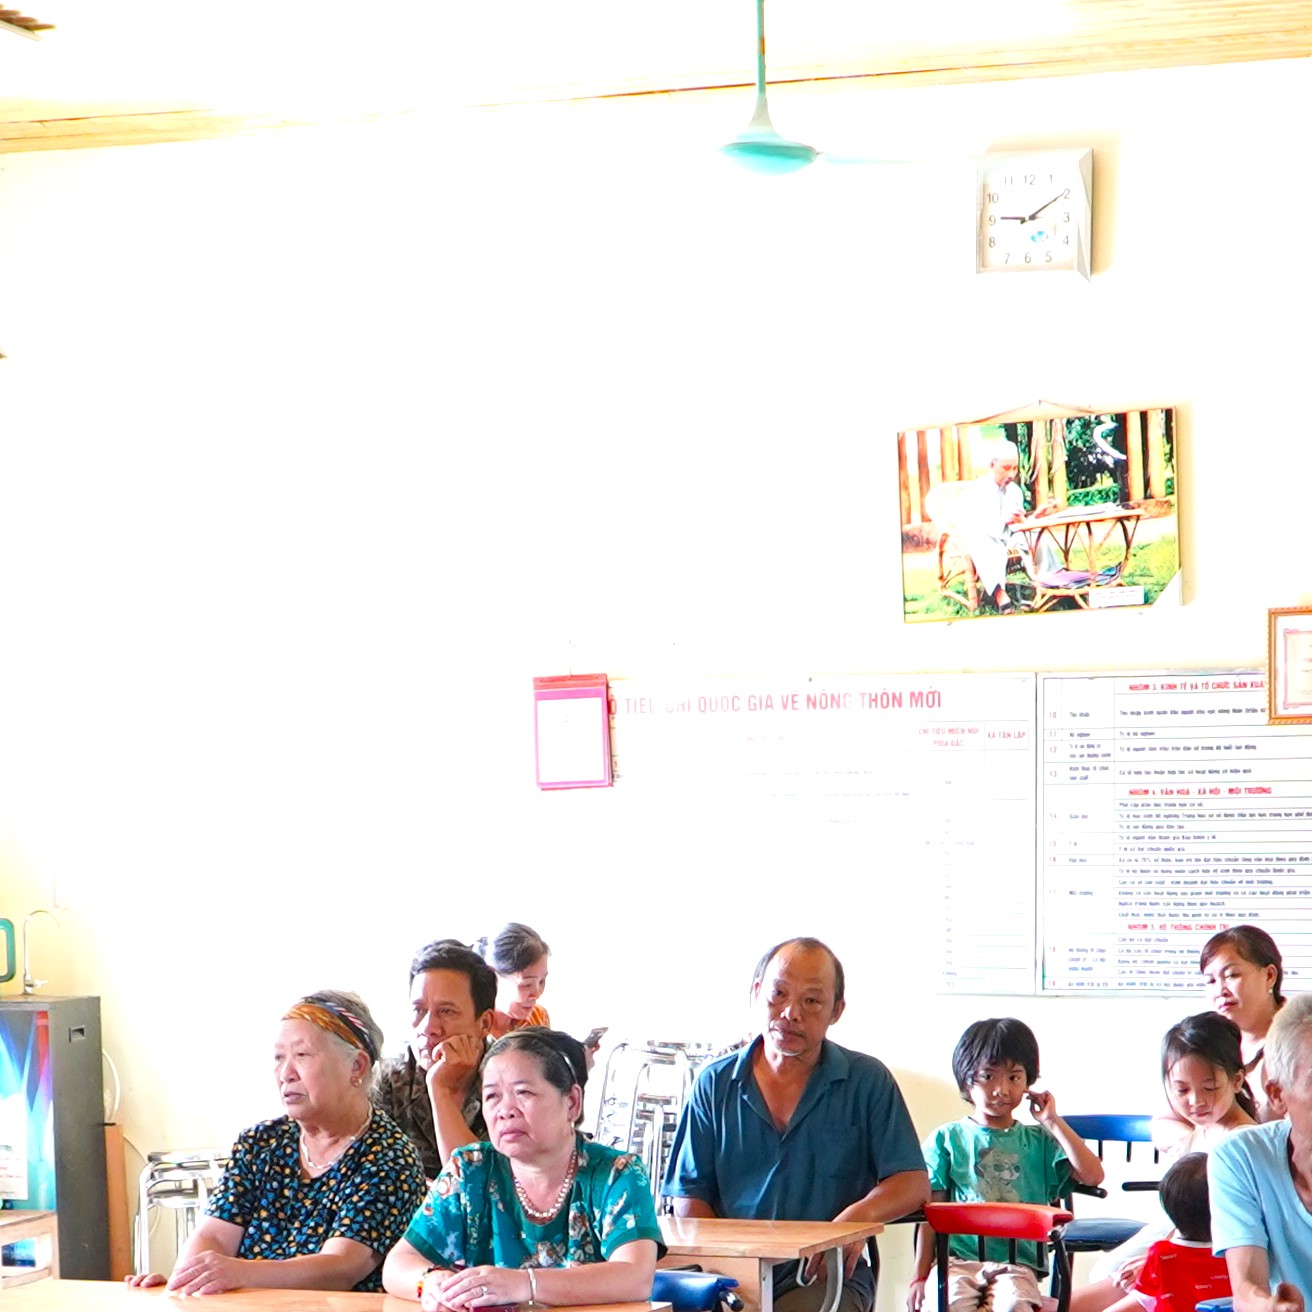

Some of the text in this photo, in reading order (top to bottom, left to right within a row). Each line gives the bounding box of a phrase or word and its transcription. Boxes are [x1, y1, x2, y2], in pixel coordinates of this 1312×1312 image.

[1024, 174, 1036, 185] 12
[987, 192, 999, 204] 10
[1063, 188, 1070, 199] 2
[989, 215, 996, 226] 9
[1063, 212, 1070, 223] 3
[989, 237, 996, 248] 8
[1063, 235, 1070, 246] 4
[1004, 252, 1010, 264] 7
[1024, 252, 1031, 263] 6
[1045, 251, 1052, 262] 5
[748, 694, 775, 712] GIA
[806, 689, 852, 710] NÔNG
[858, 688, 903, 709] THÔN
[910, 686, 942, 709] MỚI
